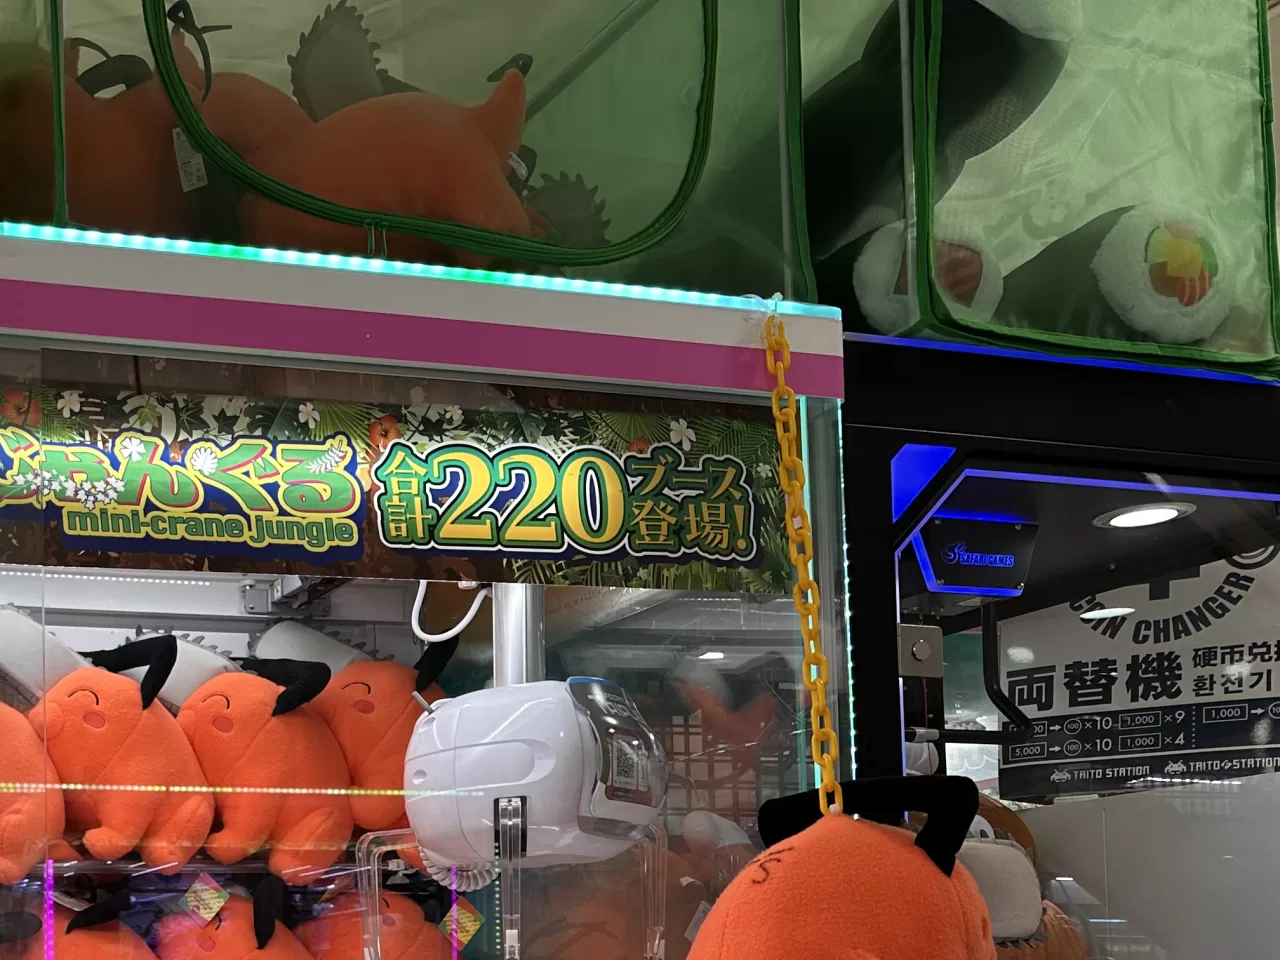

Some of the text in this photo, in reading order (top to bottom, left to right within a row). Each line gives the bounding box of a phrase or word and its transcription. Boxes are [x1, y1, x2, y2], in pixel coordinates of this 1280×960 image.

[430, 448, 625, 547] 220
[628, 453, 745, 502] ブース
[65, 508, 355, 547] mini-crane jungle
[988, 554, 1015, 567] GAMES
[1132, 571, 1256, 645] CHANGER
[1007, 651, 1183, 712] 両替機
[1193, 668, 1273, 698] 환전기
[1126, 715, 1155, 726] 1,000
[1211, 708, 1241, 719] 1,000
[1014, 746, 1041, 757] 5,000
[1126, 736, 1155, 747] 1,000
[1073, 765, 1150, 780] TAITO STATION
[1189, 760, 1222, 772] TAITO
